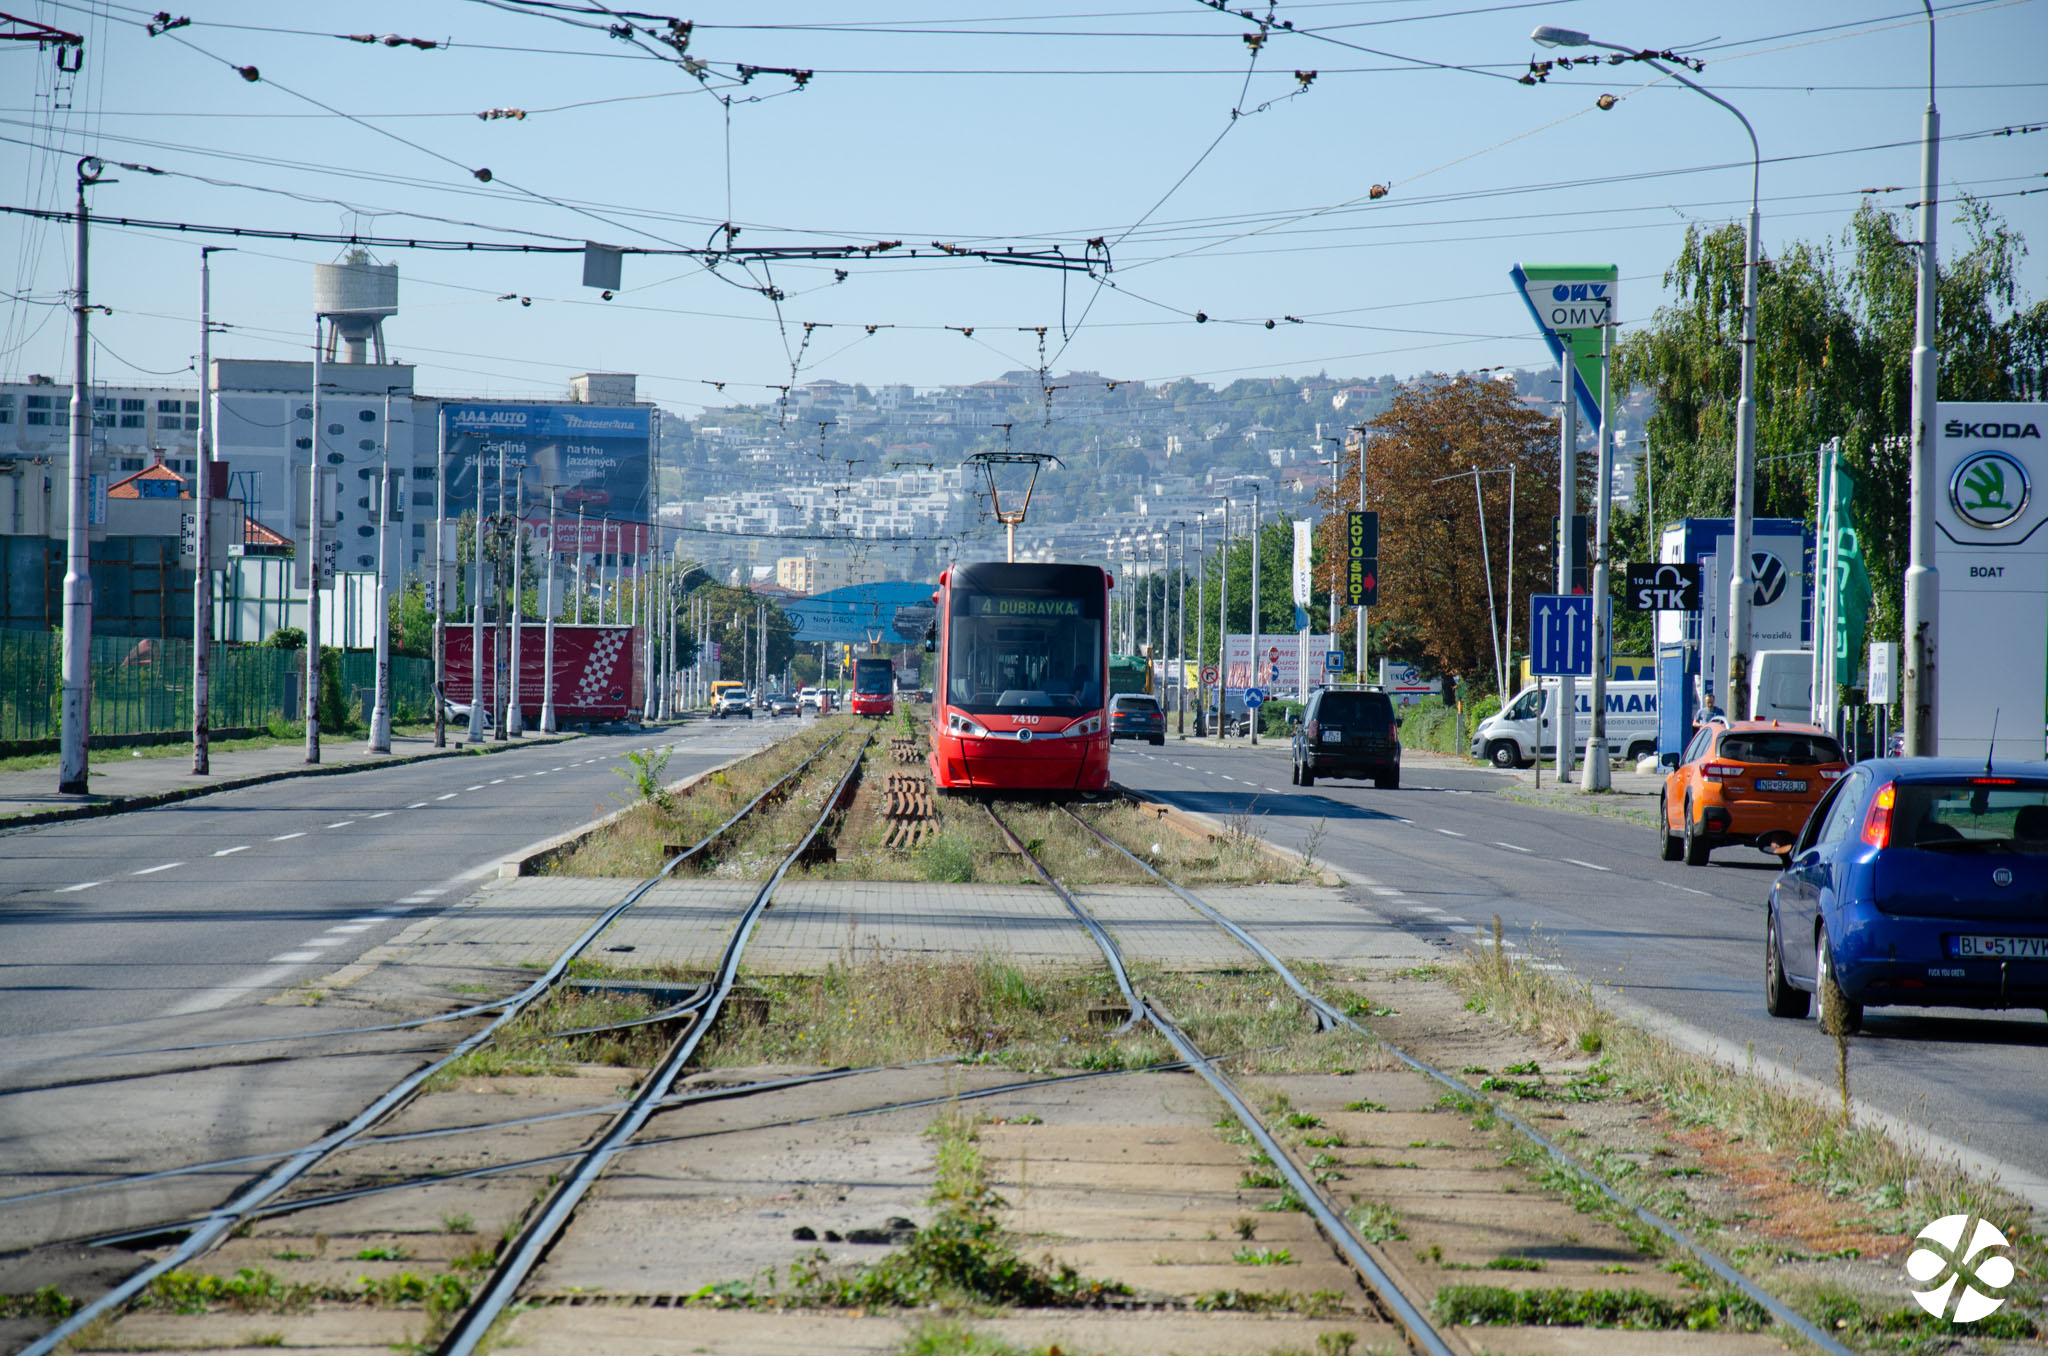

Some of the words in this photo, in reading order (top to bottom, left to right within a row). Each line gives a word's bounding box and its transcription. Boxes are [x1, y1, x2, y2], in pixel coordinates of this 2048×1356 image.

[1551, 308, 1605, 324] OMV
[457, 411, 487, 423] AAA
[489, 411, 527, 423] AUTO
[1944, 420, 2041, 439] ŠKODA
[567, 445, 580, 454] na
[582, 445, 604, 455] trhu
[566, 456, 617, 468] jazdených
[567, 468, 606, 478] vozidiel
[557, 533, 596, 543] voziiel
[1970, 567, 2005, 577] BOAT
[1639, 589, 1685, 609] STK
[982, 599, 992, 614] 4
[1575, 694, 1657, 713] LMAK
[1011, 715, 1039, 724] 7410
[1961, 937, 1985, 954] BL
[1941, 968, 1950, 977] YOU
